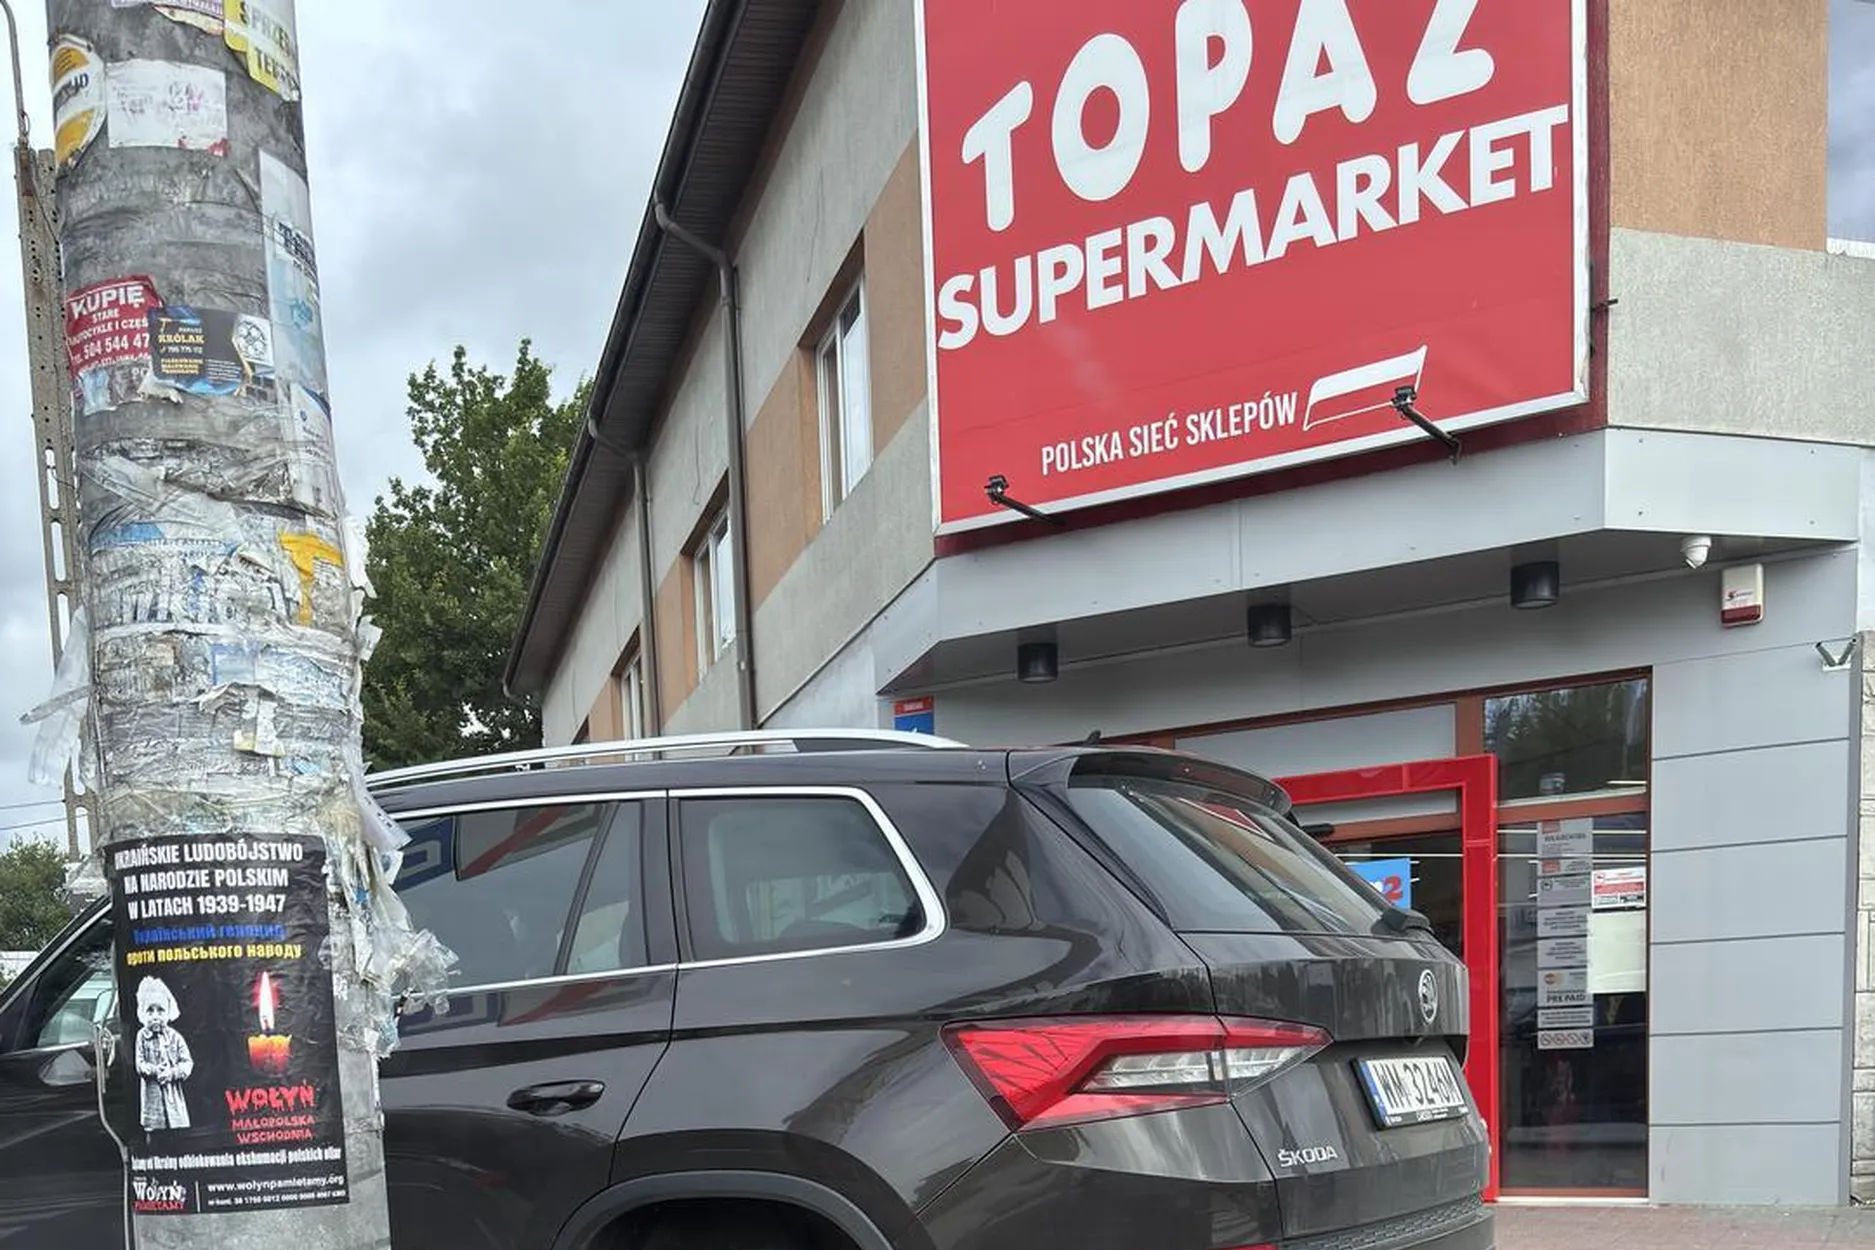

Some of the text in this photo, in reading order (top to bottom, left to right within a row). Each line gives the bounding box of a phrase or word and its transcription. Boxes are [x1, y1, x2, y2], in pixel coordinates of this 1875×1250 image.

[962, 0, 1495, 231] TOPAZ
[938, 104, 1568, 350] SUPERMARKET
[71, 285, 145, 319] KUPIĘ
[92, 308, 119, 323] STARE
[121, 317, 149, 331] CZĘŚ
[105, 335, 129, 353] 544
[133, 333, 150, 348] 47
[158, 333, 204, 344] KRÓLAK
[1041, 391, 1298, 475] POLSKA SIEĆ SKLEPÓW
[184, 838, 303, 863] LUDOBÓJSTWO
[124, 869, 288, 894] NA NARODZIE POLSKIM
[128, 894, 286, 920] W LATACH 1939-1947
[157, 946, 243, 962] польського
[247, 944, 302, 959] народу
[225, 1079, 314, 1114] WOŁYŃ
[232, 1115, 315, 1131] MAŁOPOLSKA
[236, 1129, 312, 1144] WSCHODNIA
[1278, 1146, 1338, 1167] ŠKODA
